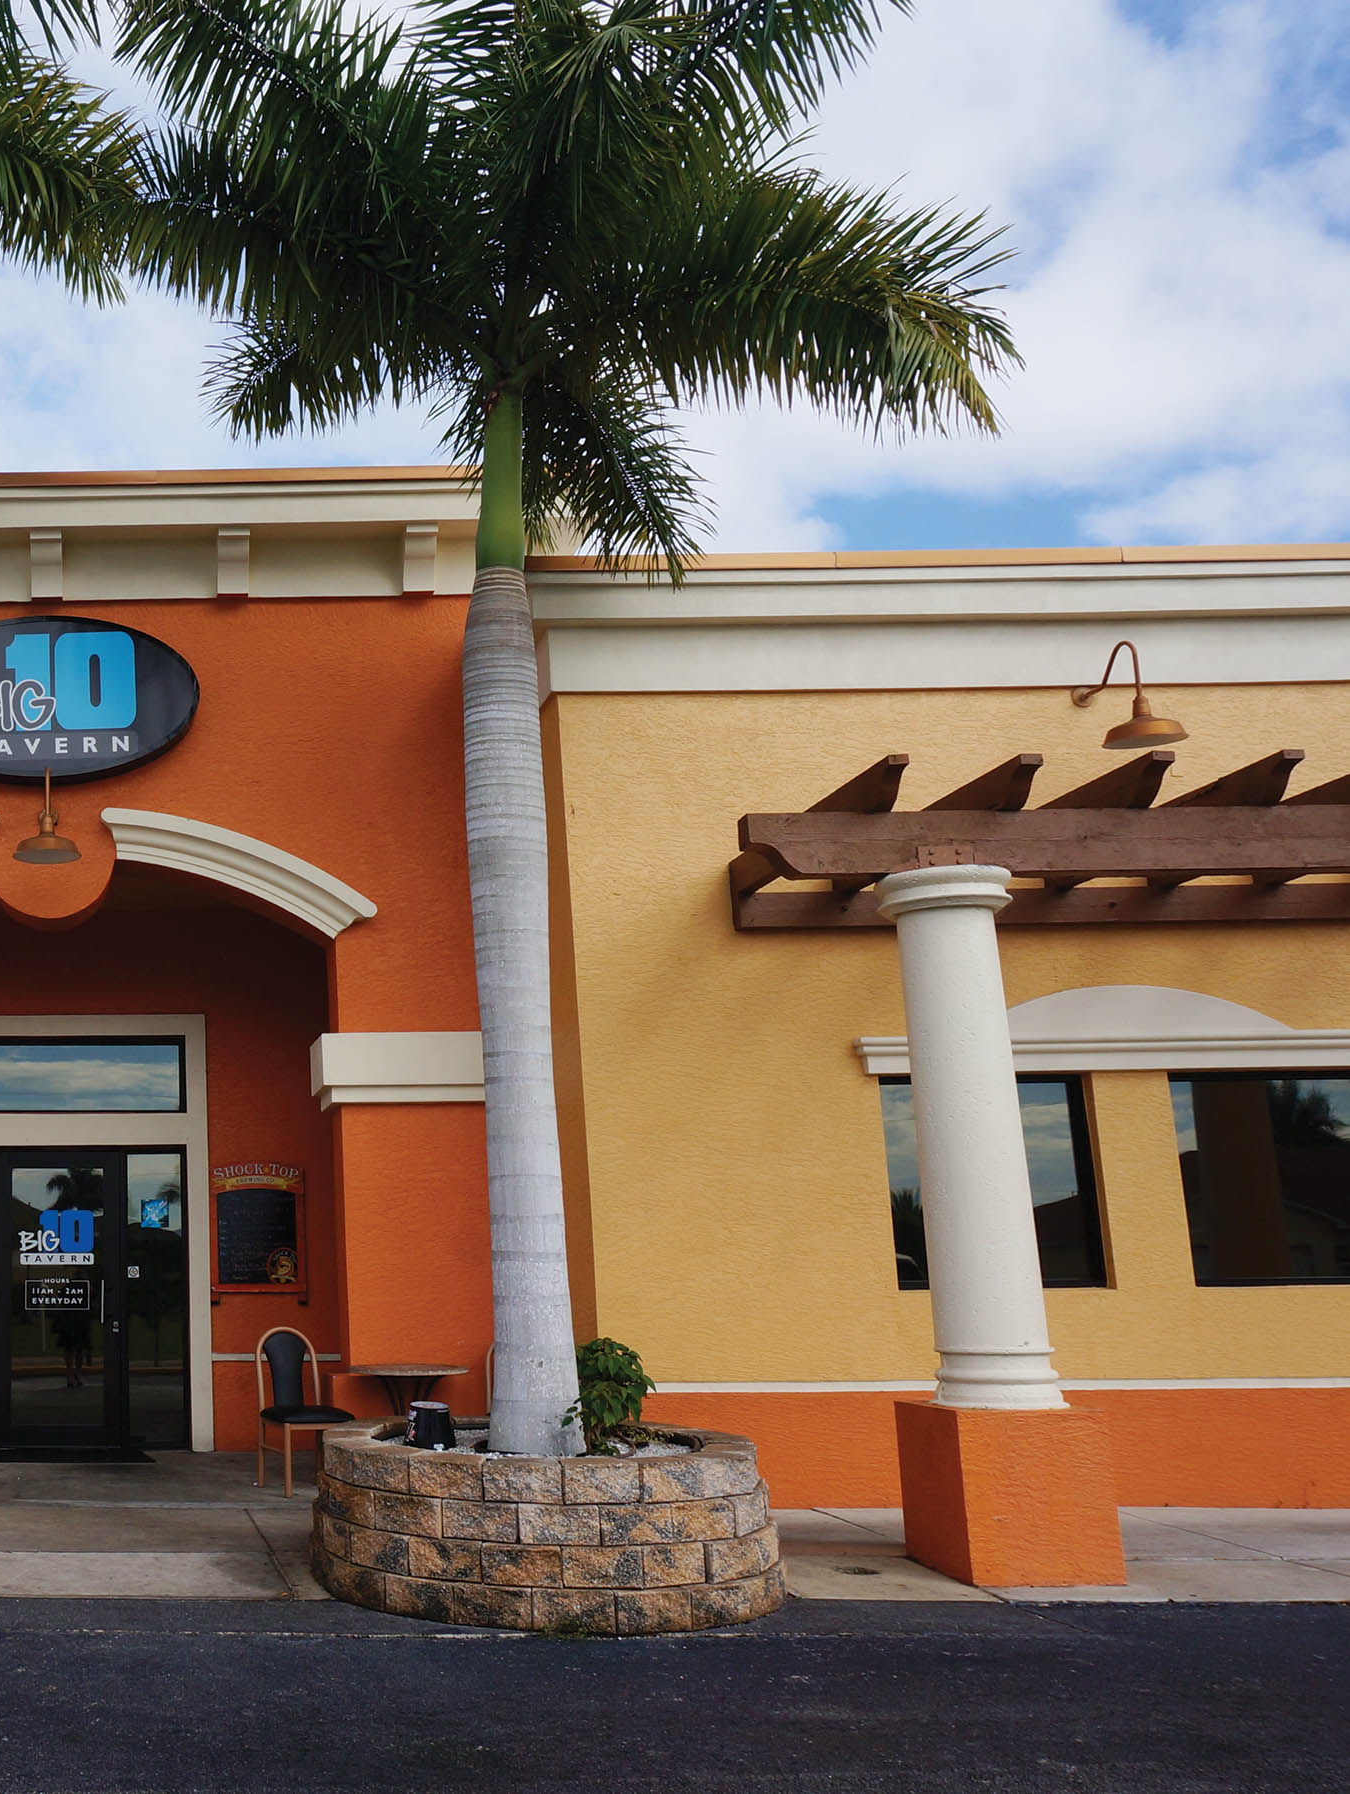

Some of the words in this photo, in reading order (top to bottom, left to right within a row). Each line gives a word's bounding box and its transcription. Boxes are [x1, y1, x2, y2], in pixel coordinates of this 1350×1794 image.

[5, 631, 137, 732] 10
[214, 1163, 264, 1178] SHOCK
[269, 1163, 299, 1178] TOP
[18, 1230, 60, 1252] BIG
[39, 1210, 94, 1252] 10
